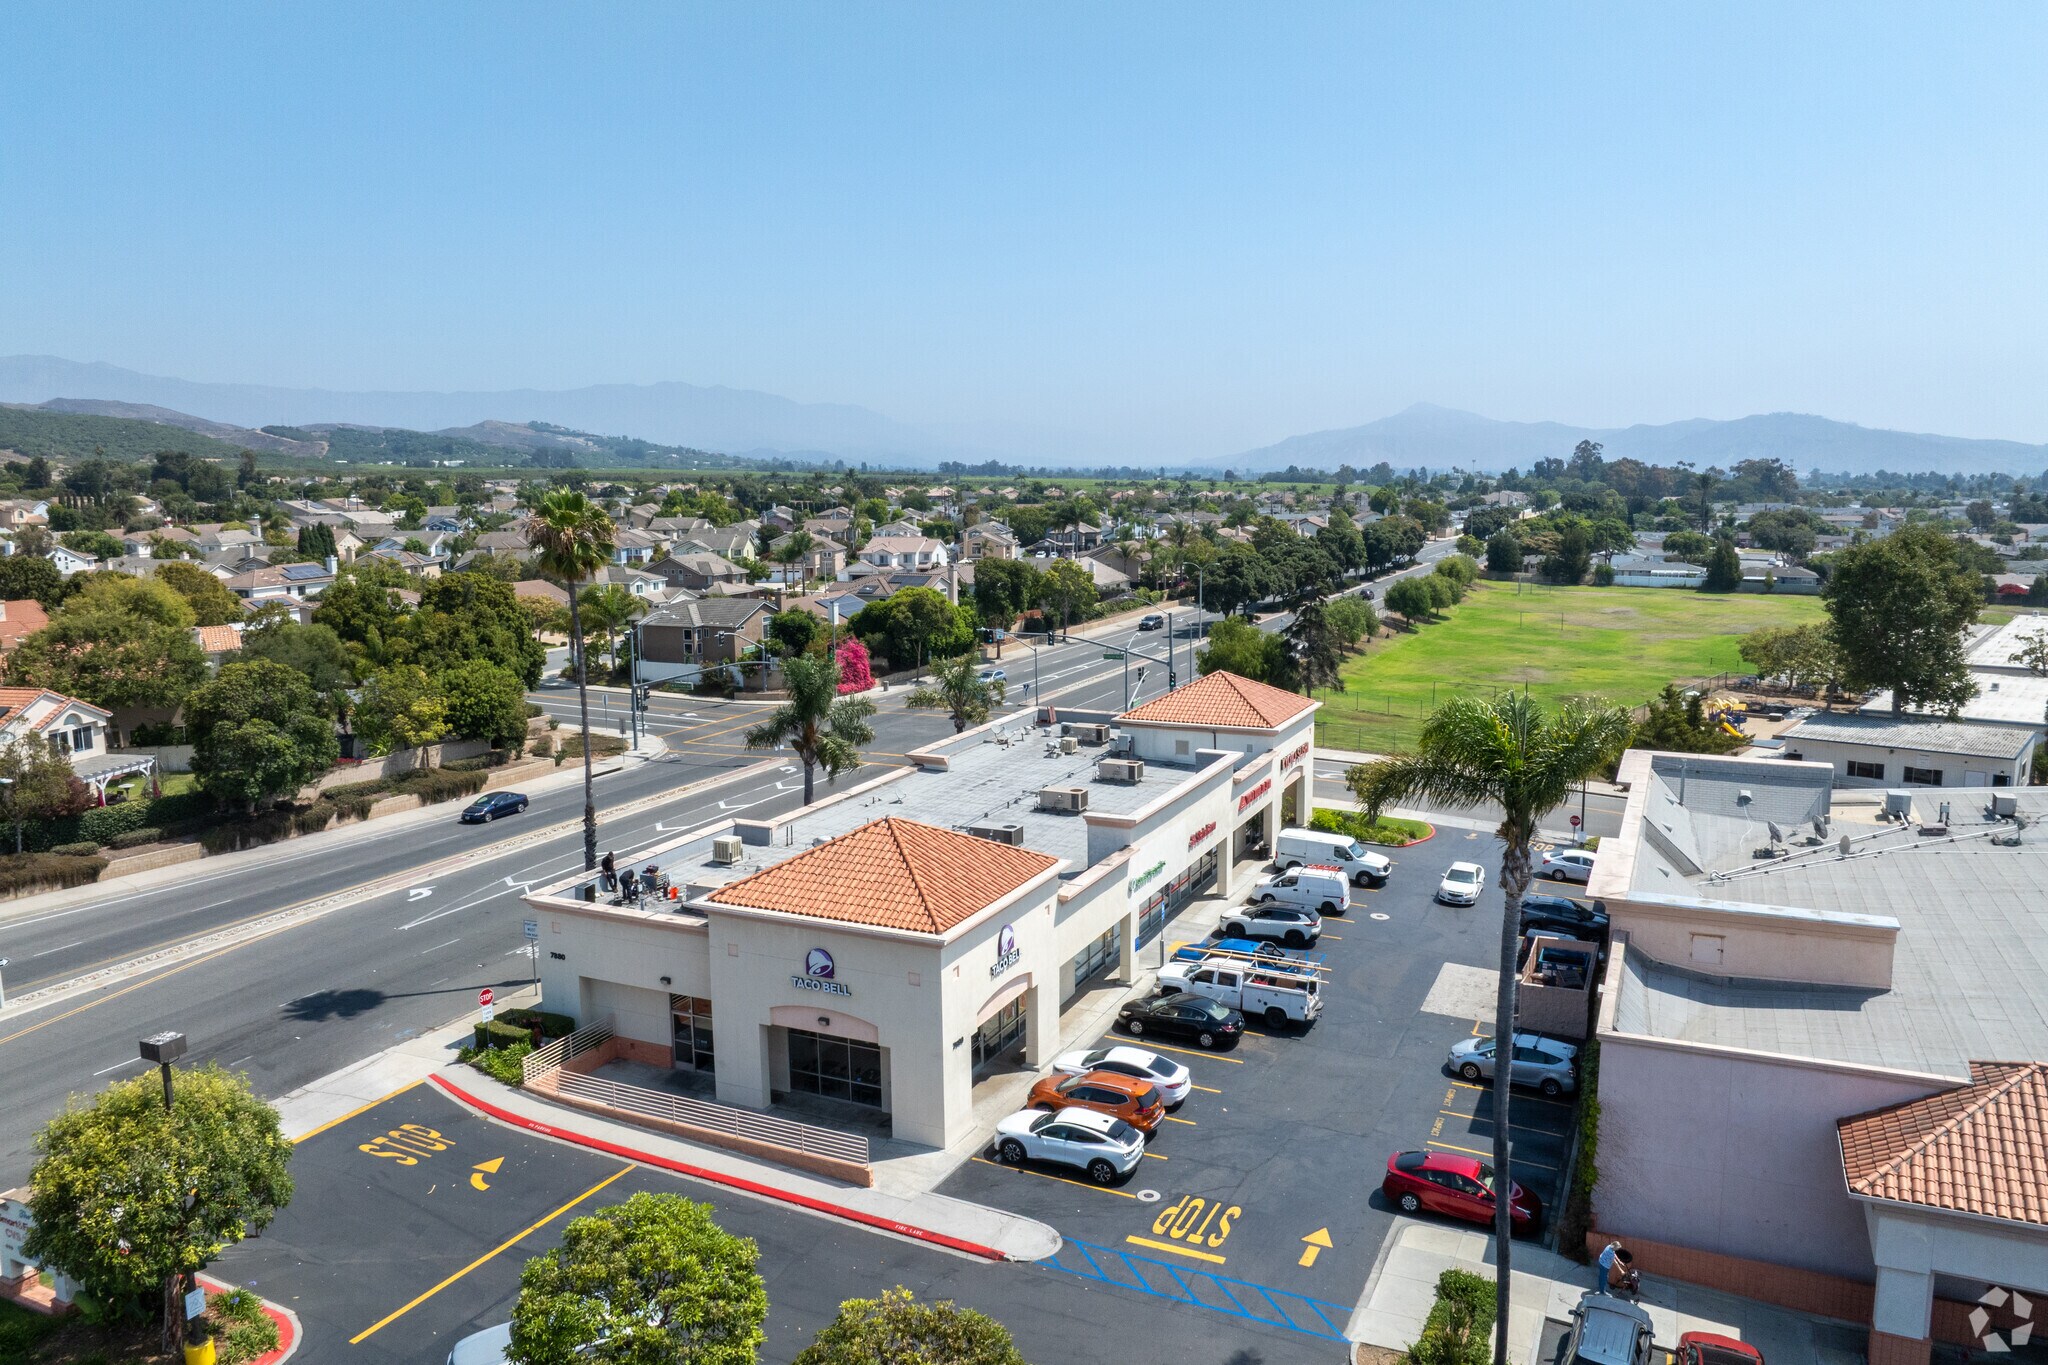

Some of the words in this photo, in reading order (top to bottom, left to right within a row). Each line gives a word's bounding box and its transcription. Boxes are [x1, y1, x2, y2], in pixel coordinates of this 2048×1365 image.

[991, 957, 1008, 976] TACO
[791, 976, 821, 991] TACO
[822, 982, 851, 996] BELL
[480, 992, 493, 1003] STOP
[358, 1123, 456, 1166] STOP
[1152, 1194, 1242, 1248] STOP
